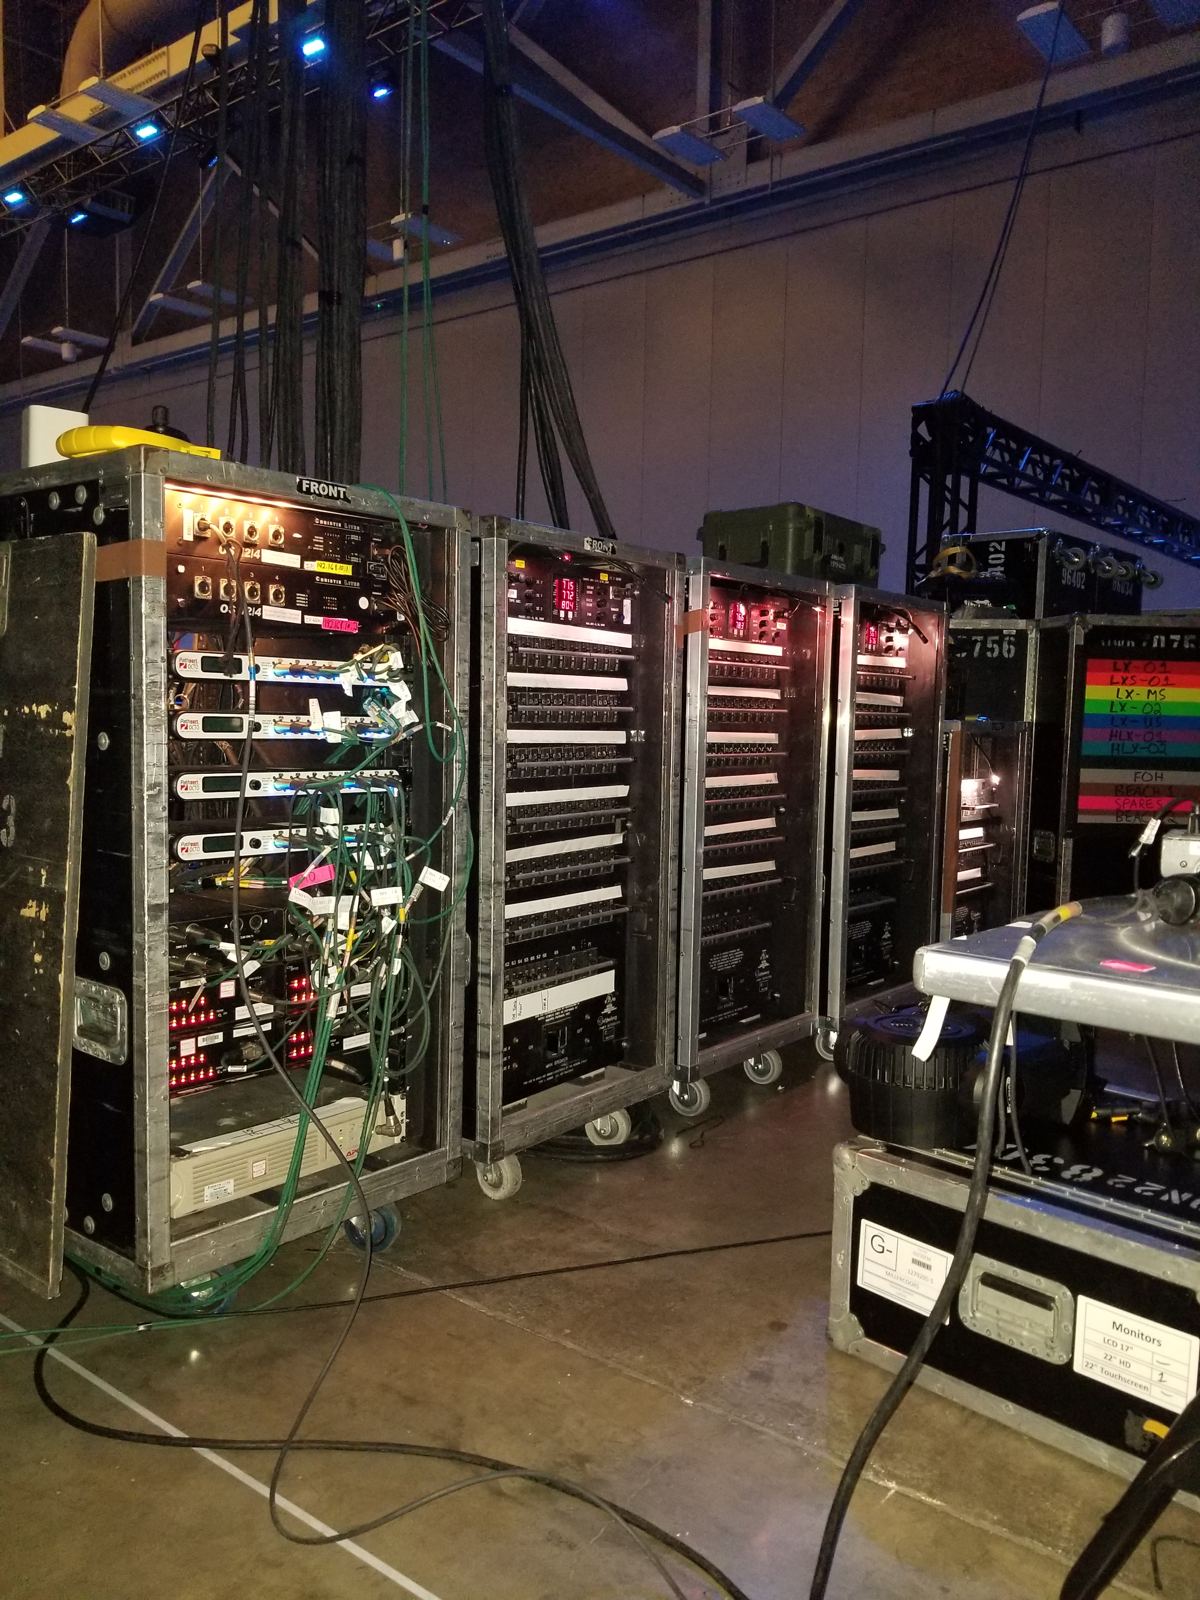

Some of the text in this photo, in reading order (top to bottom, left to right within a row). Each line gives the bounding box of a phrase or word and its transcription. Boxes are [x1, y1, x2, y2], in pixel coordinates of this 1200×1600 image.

[302, 480, 346, 499] FRONT
[1134, 772, 1164, 782] FOH
[1115, 798, 1162, 809] SPARES
[870, 1234, 893, 1254] G-
[1112, 1321, 1162, 1347] Monitors
[1103, 1337, 1134, 1352] LCD 17"
[1103, 1353, 1132, 1369] 22" HD
[1085, 1361, 1150, 1392] 22" Touchscreen
